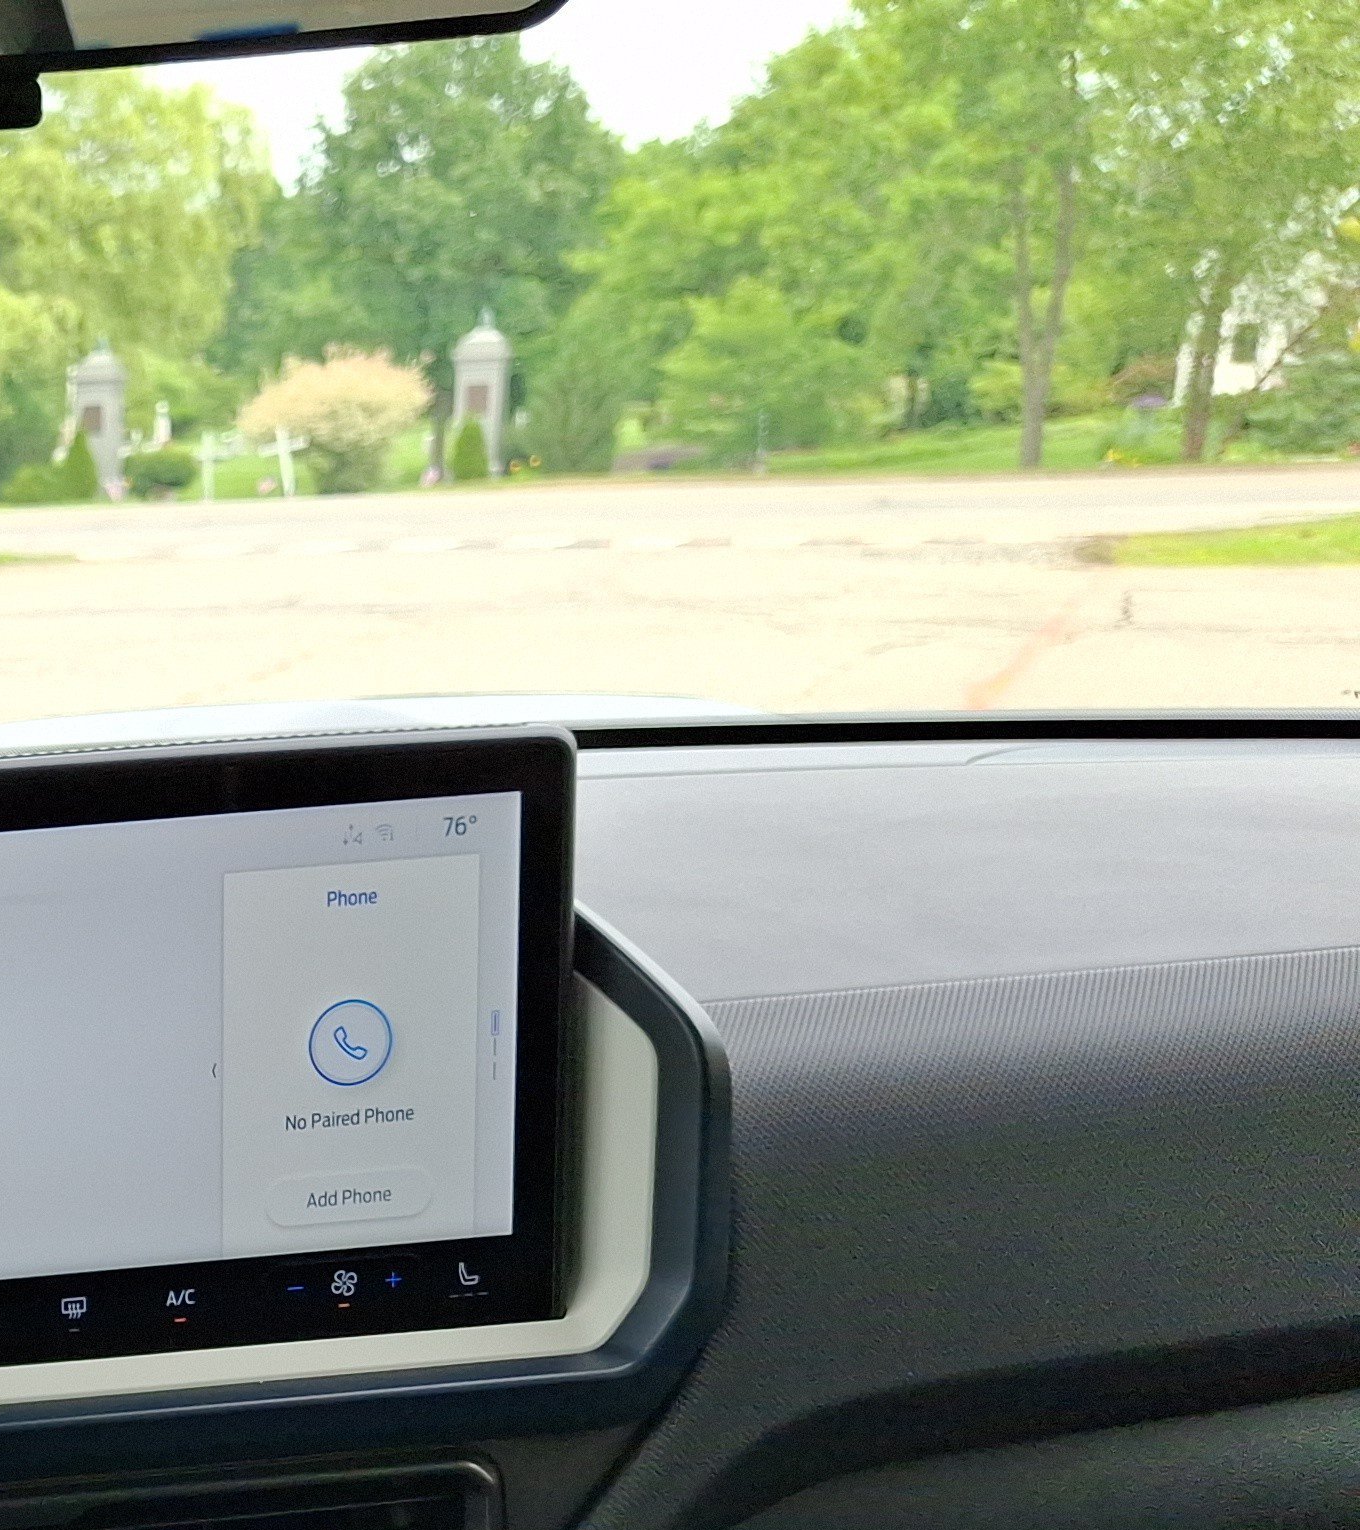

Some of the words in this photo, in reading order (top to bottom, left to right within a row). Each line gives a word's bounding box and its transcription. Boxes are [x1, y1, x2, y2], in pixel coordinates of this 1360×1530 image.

[327, 890, 378, 907] Phone
[285, 1114, 307, 1131] No
[311, 1109, 360, 1128] Paired
[364, 1107, 415, 1124] Phone
[306, 1191, 338, 1208] Add
[341, 1188, 392, 1205] Phone
[166, 1289, 196, 1307] A/C
